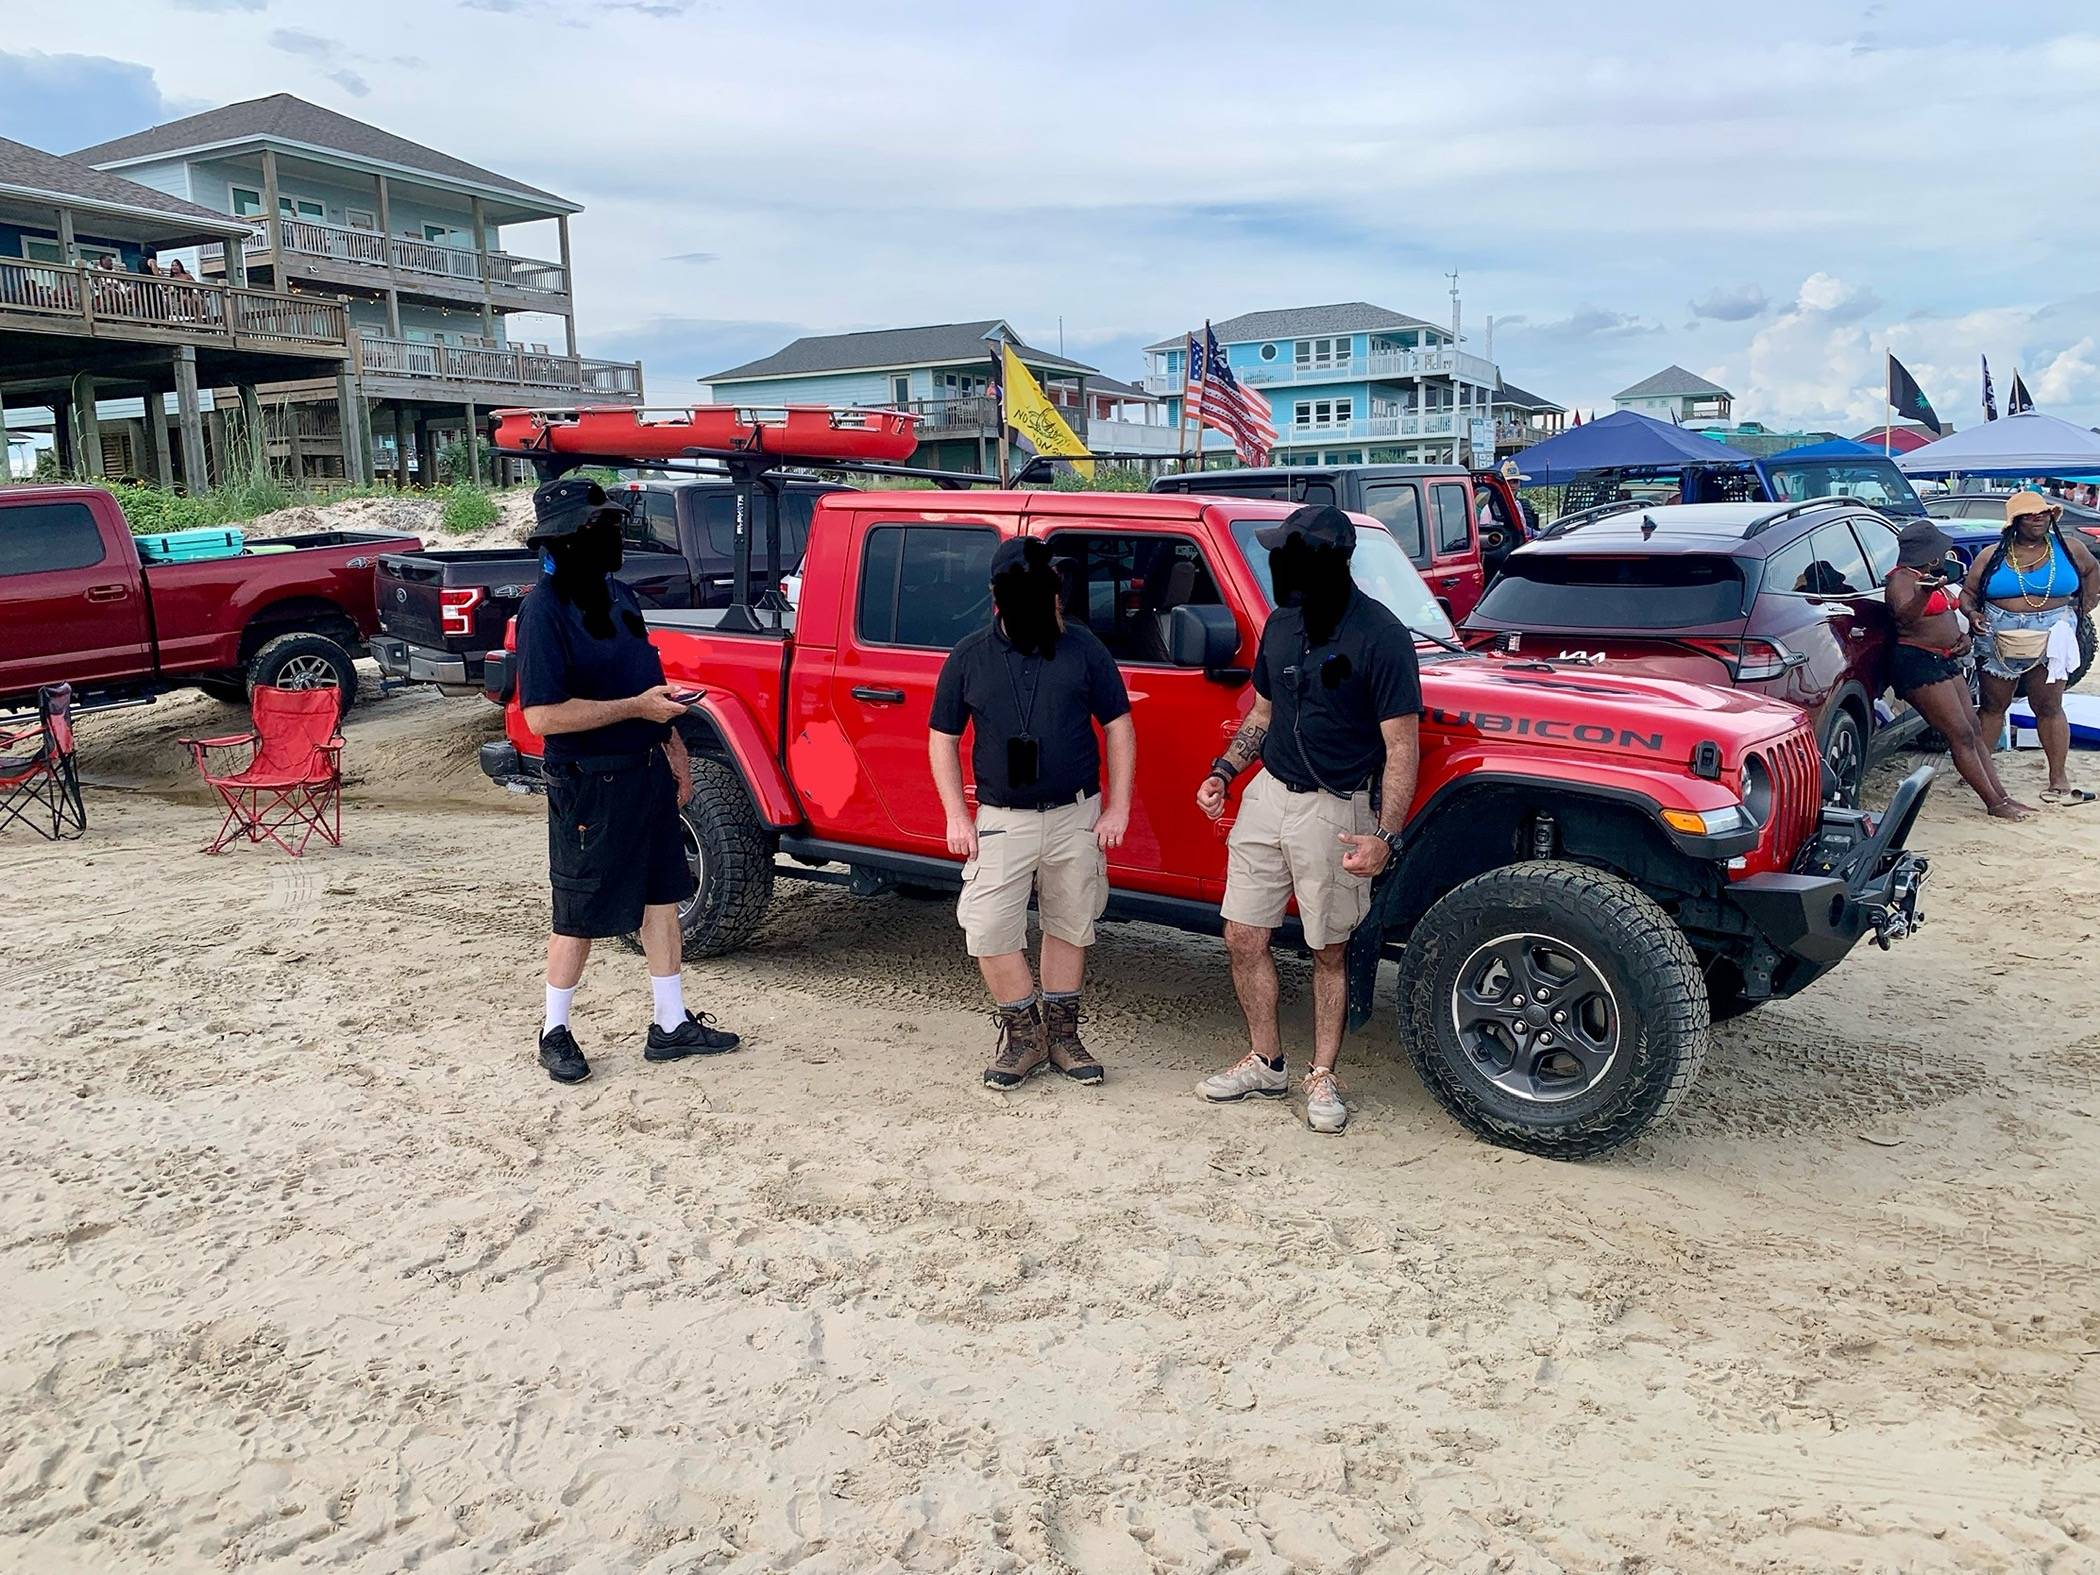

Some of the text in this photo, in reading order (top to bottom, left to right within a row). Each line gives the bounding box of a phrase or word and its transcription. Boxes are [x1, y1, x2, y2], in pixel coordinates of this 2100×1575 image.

[346, 556, 378, 569] 4X
[495, 584, 537, 600] 4X
[1421, 708, 1663, 751] UBICON
